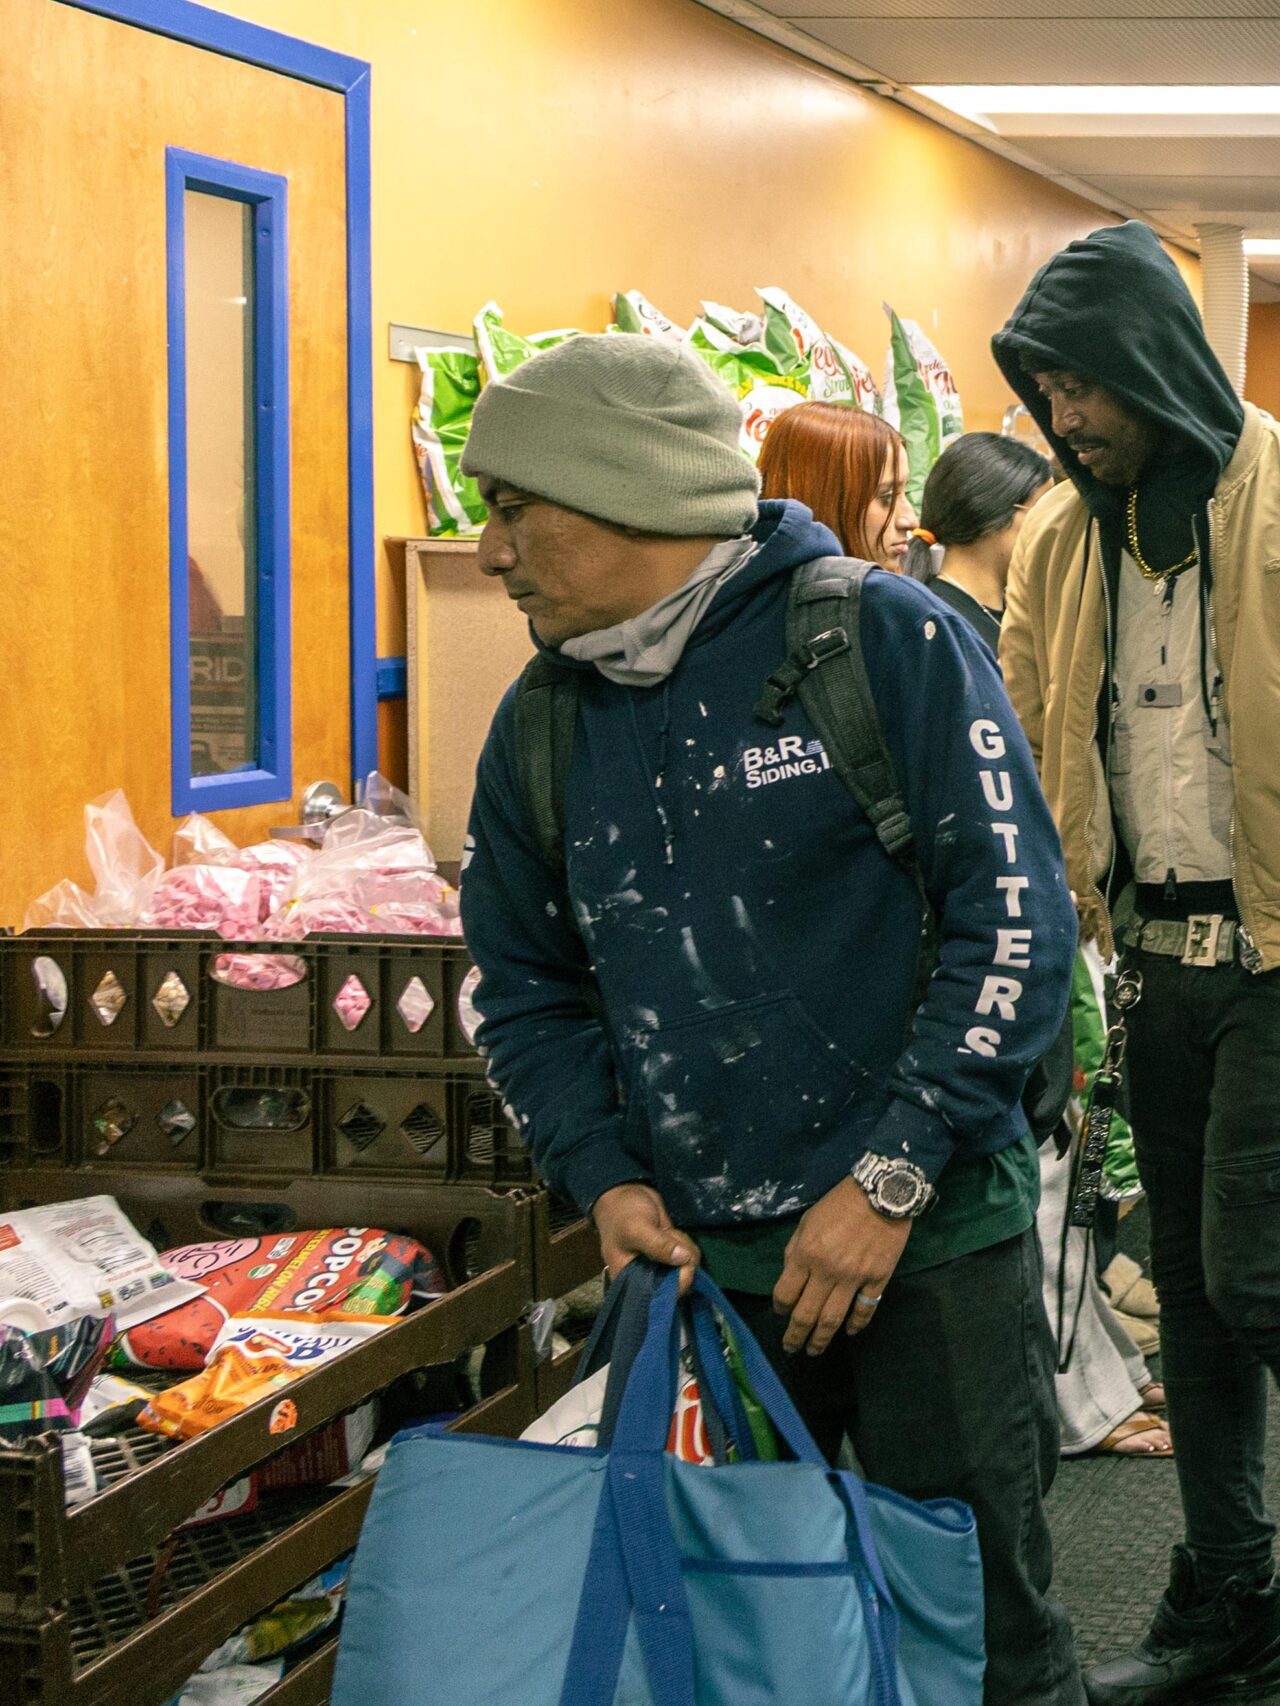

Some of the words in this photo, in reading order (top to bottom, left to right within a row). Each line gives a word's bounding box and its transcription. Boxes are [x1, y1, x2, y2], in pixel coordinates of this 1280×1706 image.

[743, 735, 806, 773] B&R
[962, 719, 1032, 1059] GUTTERS
[284, 1227, 369, 1311] OPCO
